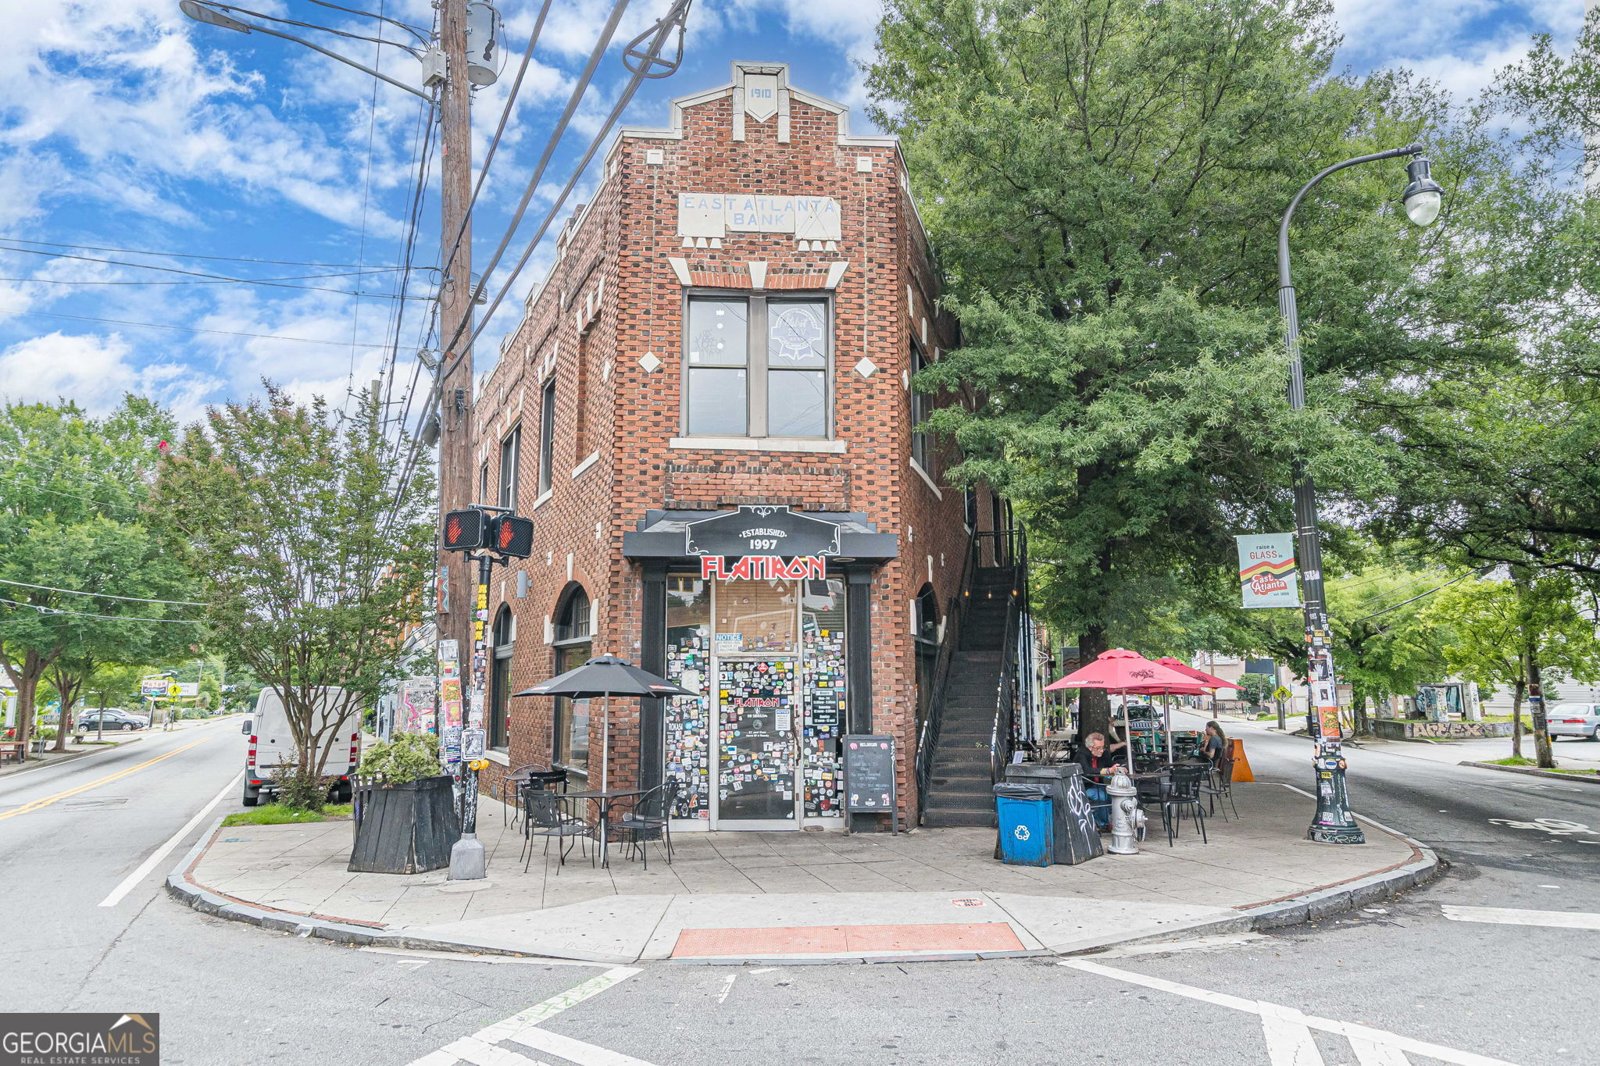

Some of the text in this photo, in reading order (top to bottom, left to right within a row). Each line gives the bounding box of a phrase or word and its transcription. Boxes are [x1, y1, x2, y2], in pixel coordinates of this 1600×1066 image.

[750, 88, 772, 99] 1910
[684, 197, 835, 212] EAST ATLANTA
[734, 213, 784, 226] BANK
[750, 539, 778, 550] 1997
[1249, 550, 1278, 560] GLASS
[700, 555, 826, 582] FLATIRON
[1252, 574, 1274, 583] East
[1253, 580, 1285, 592] Atlanta
[734, 697, 780, 708] FLATIRON
